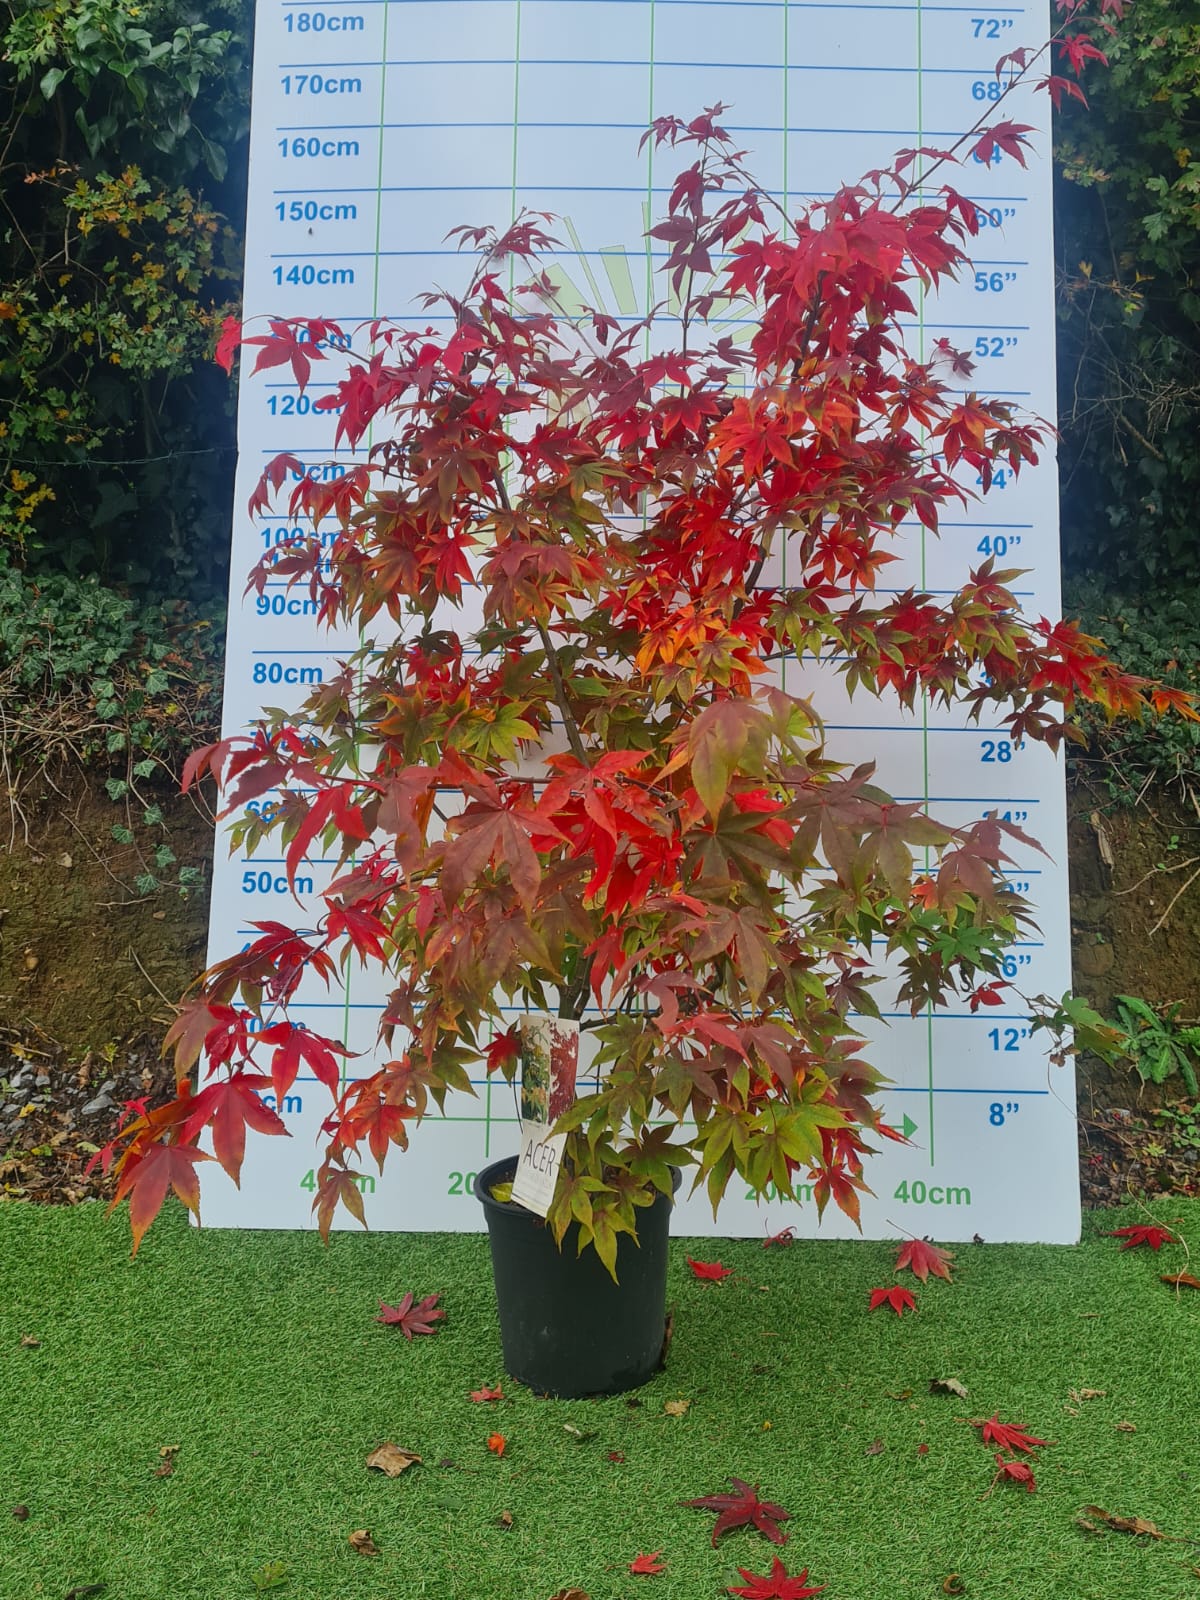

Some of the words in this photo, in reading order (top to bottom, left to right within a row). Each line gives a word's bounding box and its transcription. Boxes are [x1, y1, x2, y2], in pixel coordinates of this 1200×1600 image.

[284, 12, 365, 33] 180cm
[281, 74, 362, 95] 170cm
[278, 137, 360, 158] 160cm
[275, 200, 357, 222] 150cm
[272, 264, 355, 285] 140cm
[253, 662, 323, 684] 80cm
[241, 871, 313, 894] 50cm
[523, 1138, 556, 1177] ACER
[893, 1180, 972, 1205] 40cm
